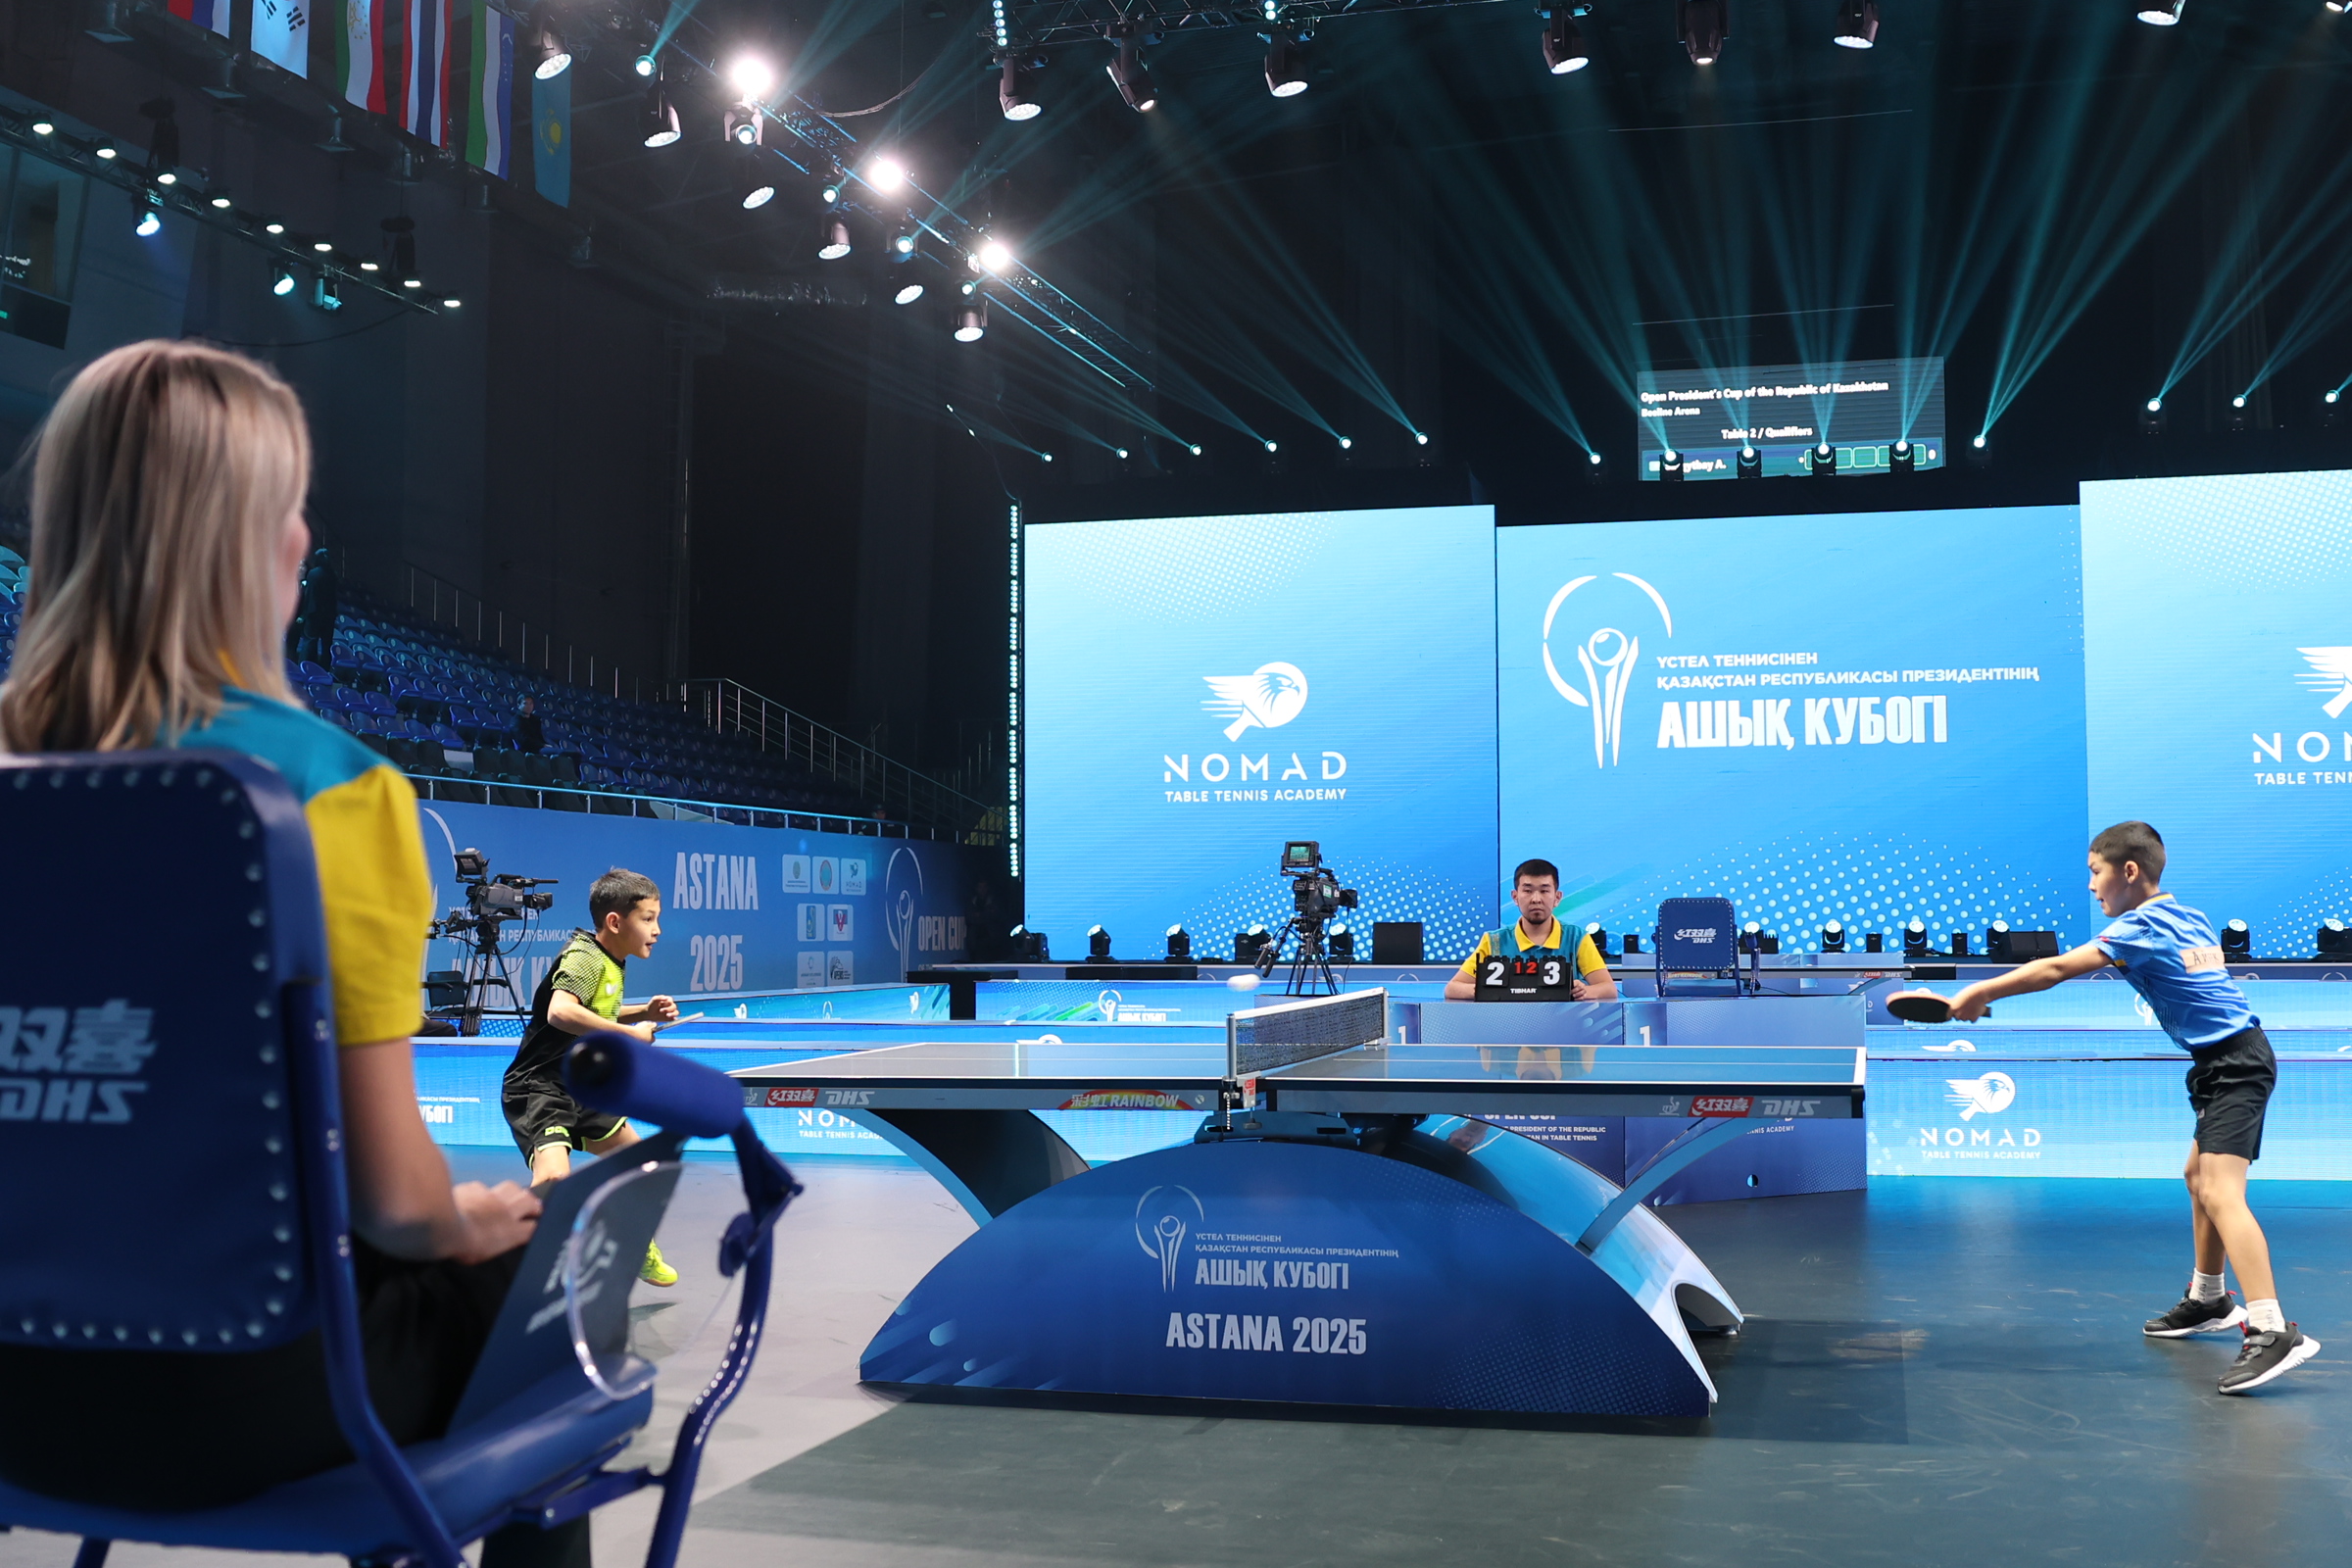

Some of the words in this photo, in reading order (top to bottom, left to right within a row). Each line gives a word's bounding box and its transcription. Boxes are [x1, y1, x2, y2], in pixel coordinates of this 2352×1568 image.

[1641, 392, 1666, 405] Open
[1668, 389, 1722, 402] President's
[1723, 388, 1742, 401] Cup
[1744, 386, 1756, 398] of
[1757, 386, 1774, 397] the
[1776, 383, 1818, 398] Republic
[1820, 383, 1832, 394] of
[1833, 381, 1889, 393] Kazakhstan
[1641, 408, 1673, 417] Beeline
[1674, 406, 1700, 416] Arena
[1721, 428, 1748, 440] Table
[1749, 427, 1757, 438] 2
[1758, 427, 1765, 439] /
[1765, 426, 1813, 438] Qualifiers
[1713, 653, 1818, 667] ТЕННИСІНЕН
[1656, 674, 1756, 690] ҚАЗАҚСТАН
[1760, 670, 1898, 686] РЕСПУБЛИКАСЫ
[1902, 666, 2040, 683] ПРЕЗИДЕНТІНІҢ
[1656, 698, 1795, 751] АШЫҚ
[1804, 695, 1948, 746] КУБОГІ
[1163, 751, 1348, 783] NOMAD
[2254, 771, 2307, 785] TABLE
[1164, 791, 1209, 803] TABLE
[1214, 789, 1269, 802] TENNIS
[1274, 788, 1348, 801] ACADEMY
[672, 852, 760, 910] ASTANA
[918, 915, 946, 951] OPEN
[948, 915, 967, 951] CUP
[690, 934, 743, 992] 2025
[1486, 961, 1504, 986] 2
[1514, 961, 1522, 974] 1
[1525, 961, 1538, 974] 2
[1543, 961, 1561, 985] 3
[825, 1091, 875, 1105] DHS
[1109, 1094, 1179, 1108] RAINBOW
[418, 1104, 454, 1123] УБОГІ
[1762, 1100, 1821, 1116] DHS
[798, 1109, 857, 1128] NOM
[826, 1130, 856, 1139] TENNIS
[1921, 1127, 2041, 1147] NOMAD
[1922, 1151, 1950, 1159] TABLE
[1955, 1151, 1990, 1159] TENNIS
[1993, 1151, 2041, 1159] ACADEMY
[1226, 1233, 1282, 1243] ТЕННИСІНЕН
[1196, 1244, 1249, 1253] ҚАЗАҚСТАН
[1250, 1246, 1324, 1255] РЕСПУБЛИКАСЫ
[1326, 1248, 1399, 1258] ПРЕЗИДЕНТІНІҢ
[1195, 1258, 1268, 1290] АШЫҚ
[1273, 1260, 1349, 1290] КУБОГІ
[1165, 1312, 1284, 1351] ASTANA
[1293, 1316, 1367, 1354] 2025
